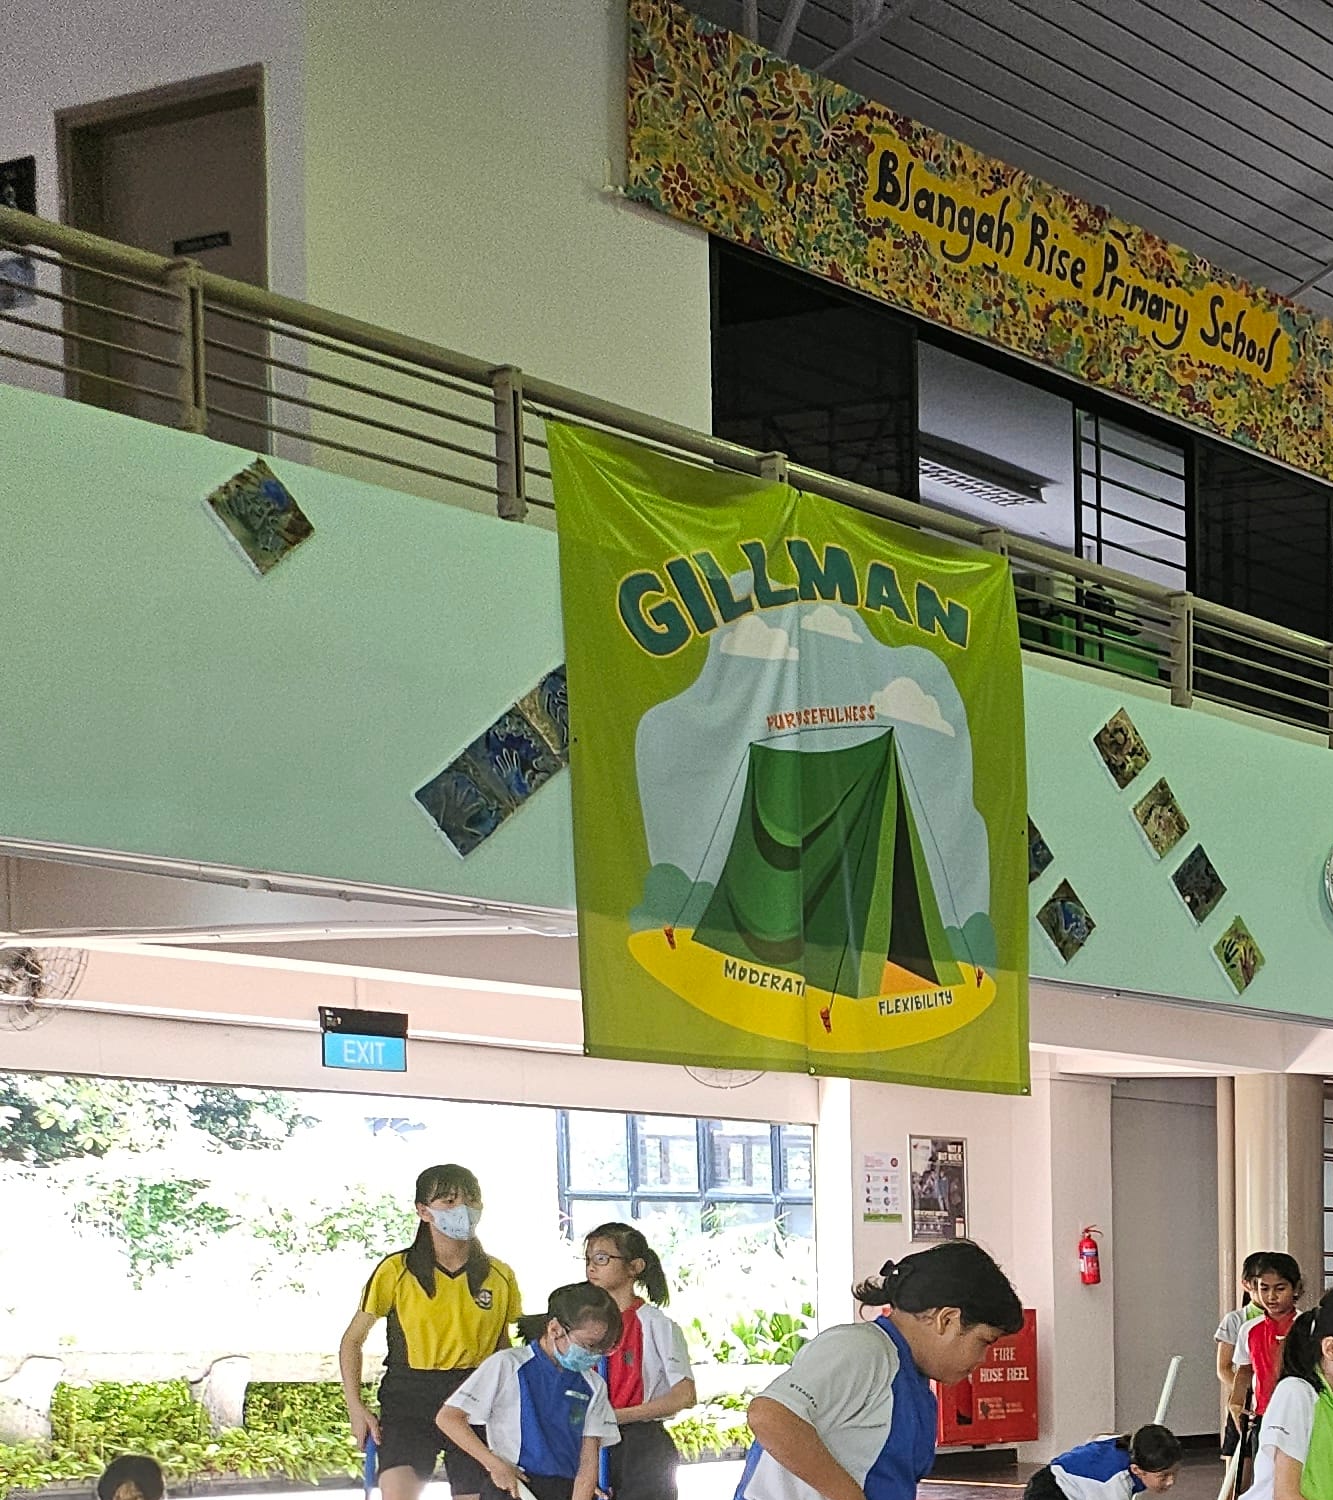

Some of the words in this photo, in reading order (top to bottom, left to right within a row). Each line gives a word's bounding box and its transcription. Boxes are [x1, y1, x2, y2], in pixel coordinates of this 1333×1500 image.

[873, 150, 1015, 263] Blangah
[1024, 213, 1086, 288] Rise
[1093, 242, 1188, 350] Primary
[1201, 296, 1281, 373] School
[617, 536, 971, 657] GILLMAN
[879, 991, 953, 1015] FLEXIBILITY
[343, 1039, 386, 1065] EXIT
[993, 1347, 1017, 1361] FIRE
[980, 1367, 1004, 1382] HOSE
[1007, 1366, 1029, 1381] REEL
